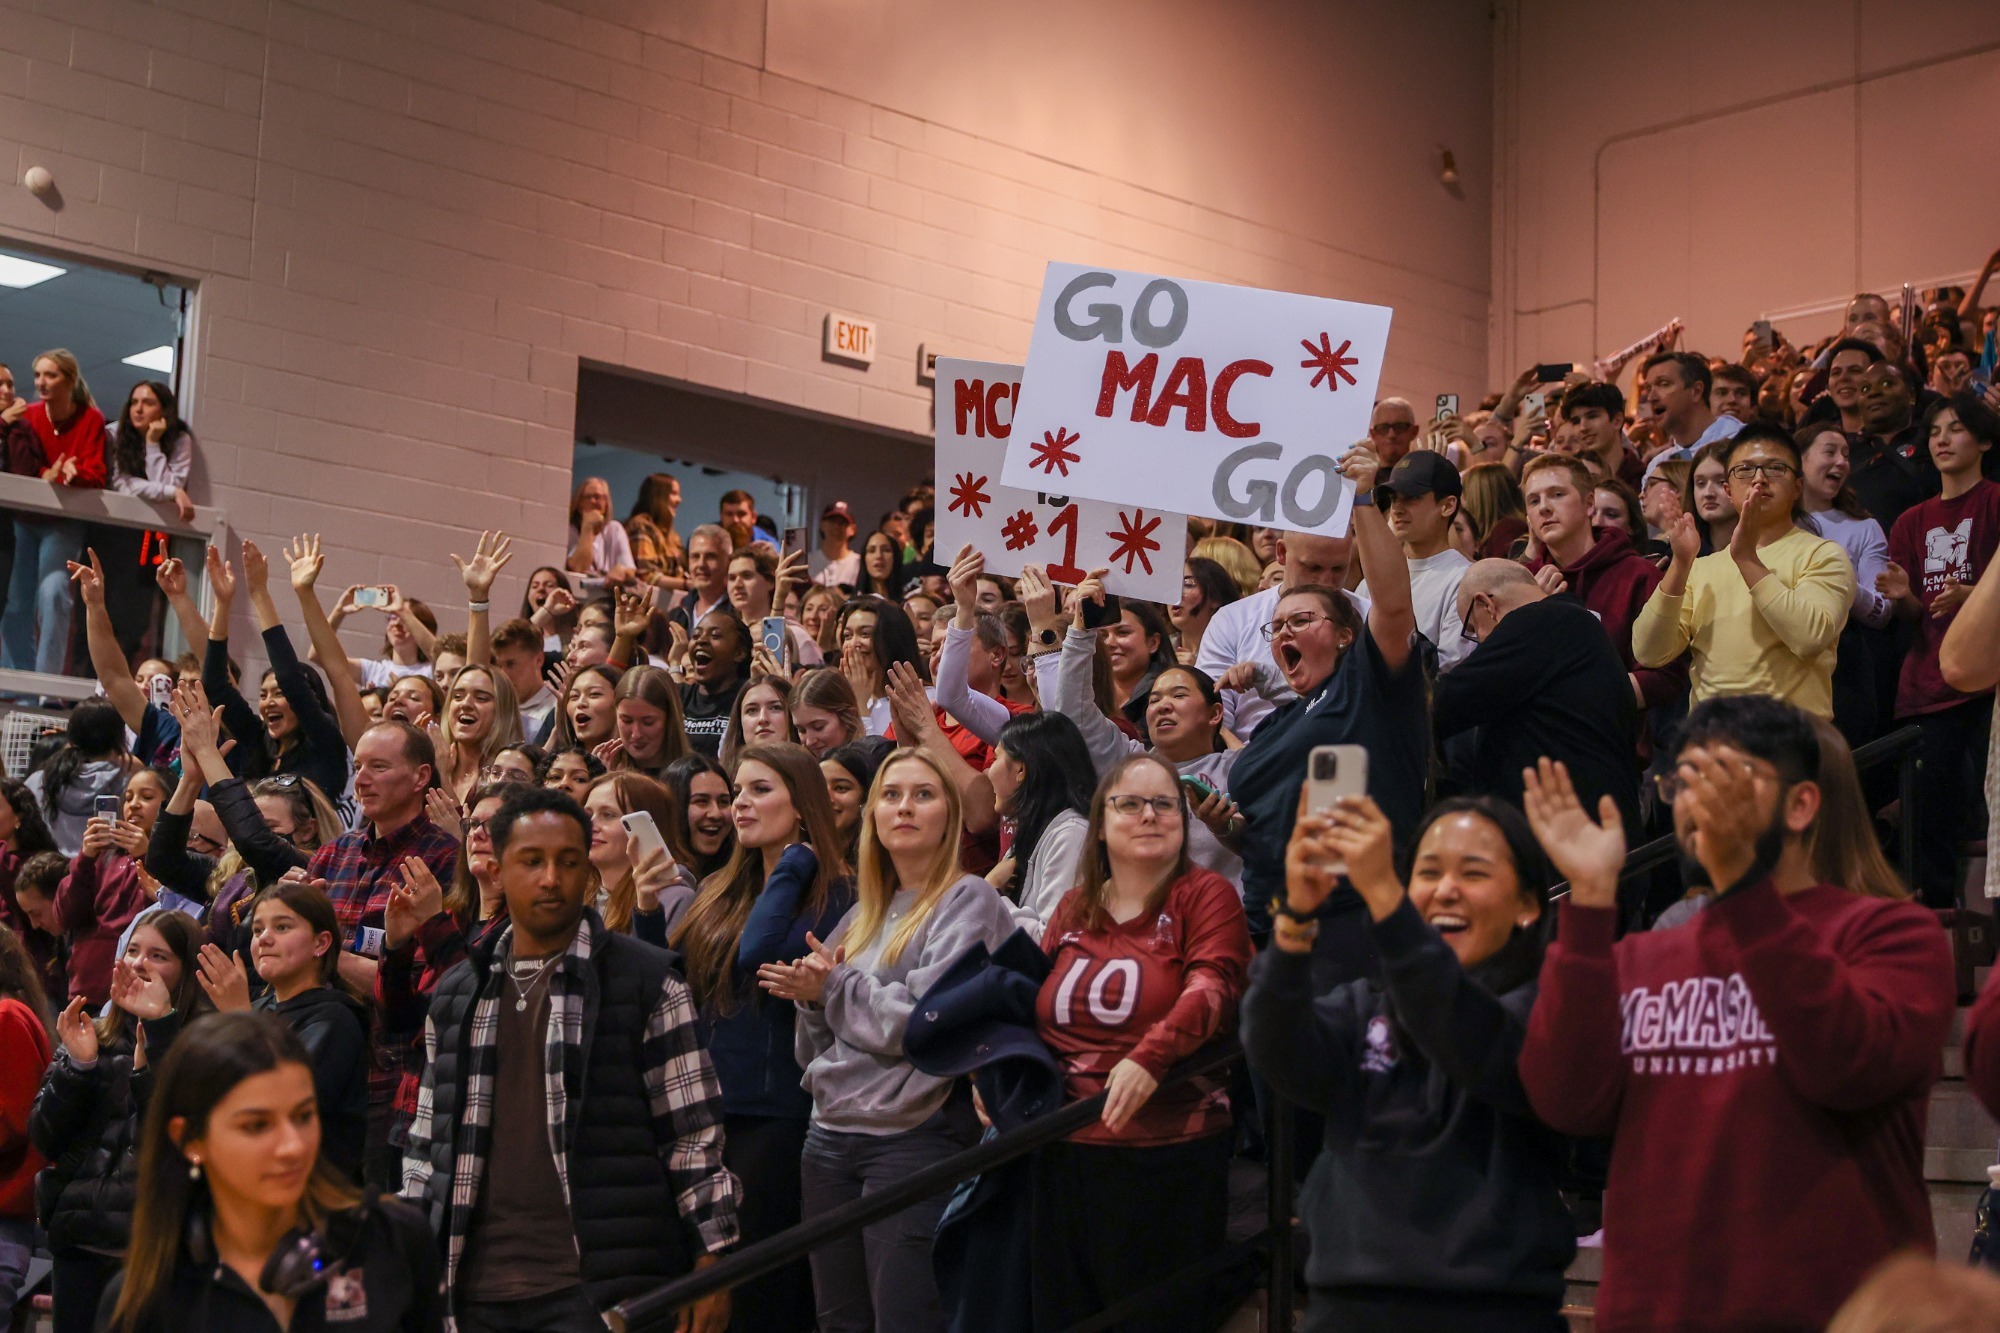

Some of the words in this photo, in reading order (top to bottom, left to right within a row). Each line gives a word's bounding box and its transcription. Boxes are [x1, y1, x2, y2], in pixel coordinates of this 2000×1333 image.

[837, 321, 869, 354] EXIT
[1054, 272, 1188, 348] GO
[954, 379, 1021, 439] MC
[1095, 350, 1275, 438] MAC
[1212, 442, 1342, 527] GO
[684, 719, 729, 728] McMASTE
[1054, 957, 1141, 1025] 10
[1633, 1047, 1777, 1075] UNIVERSITY
